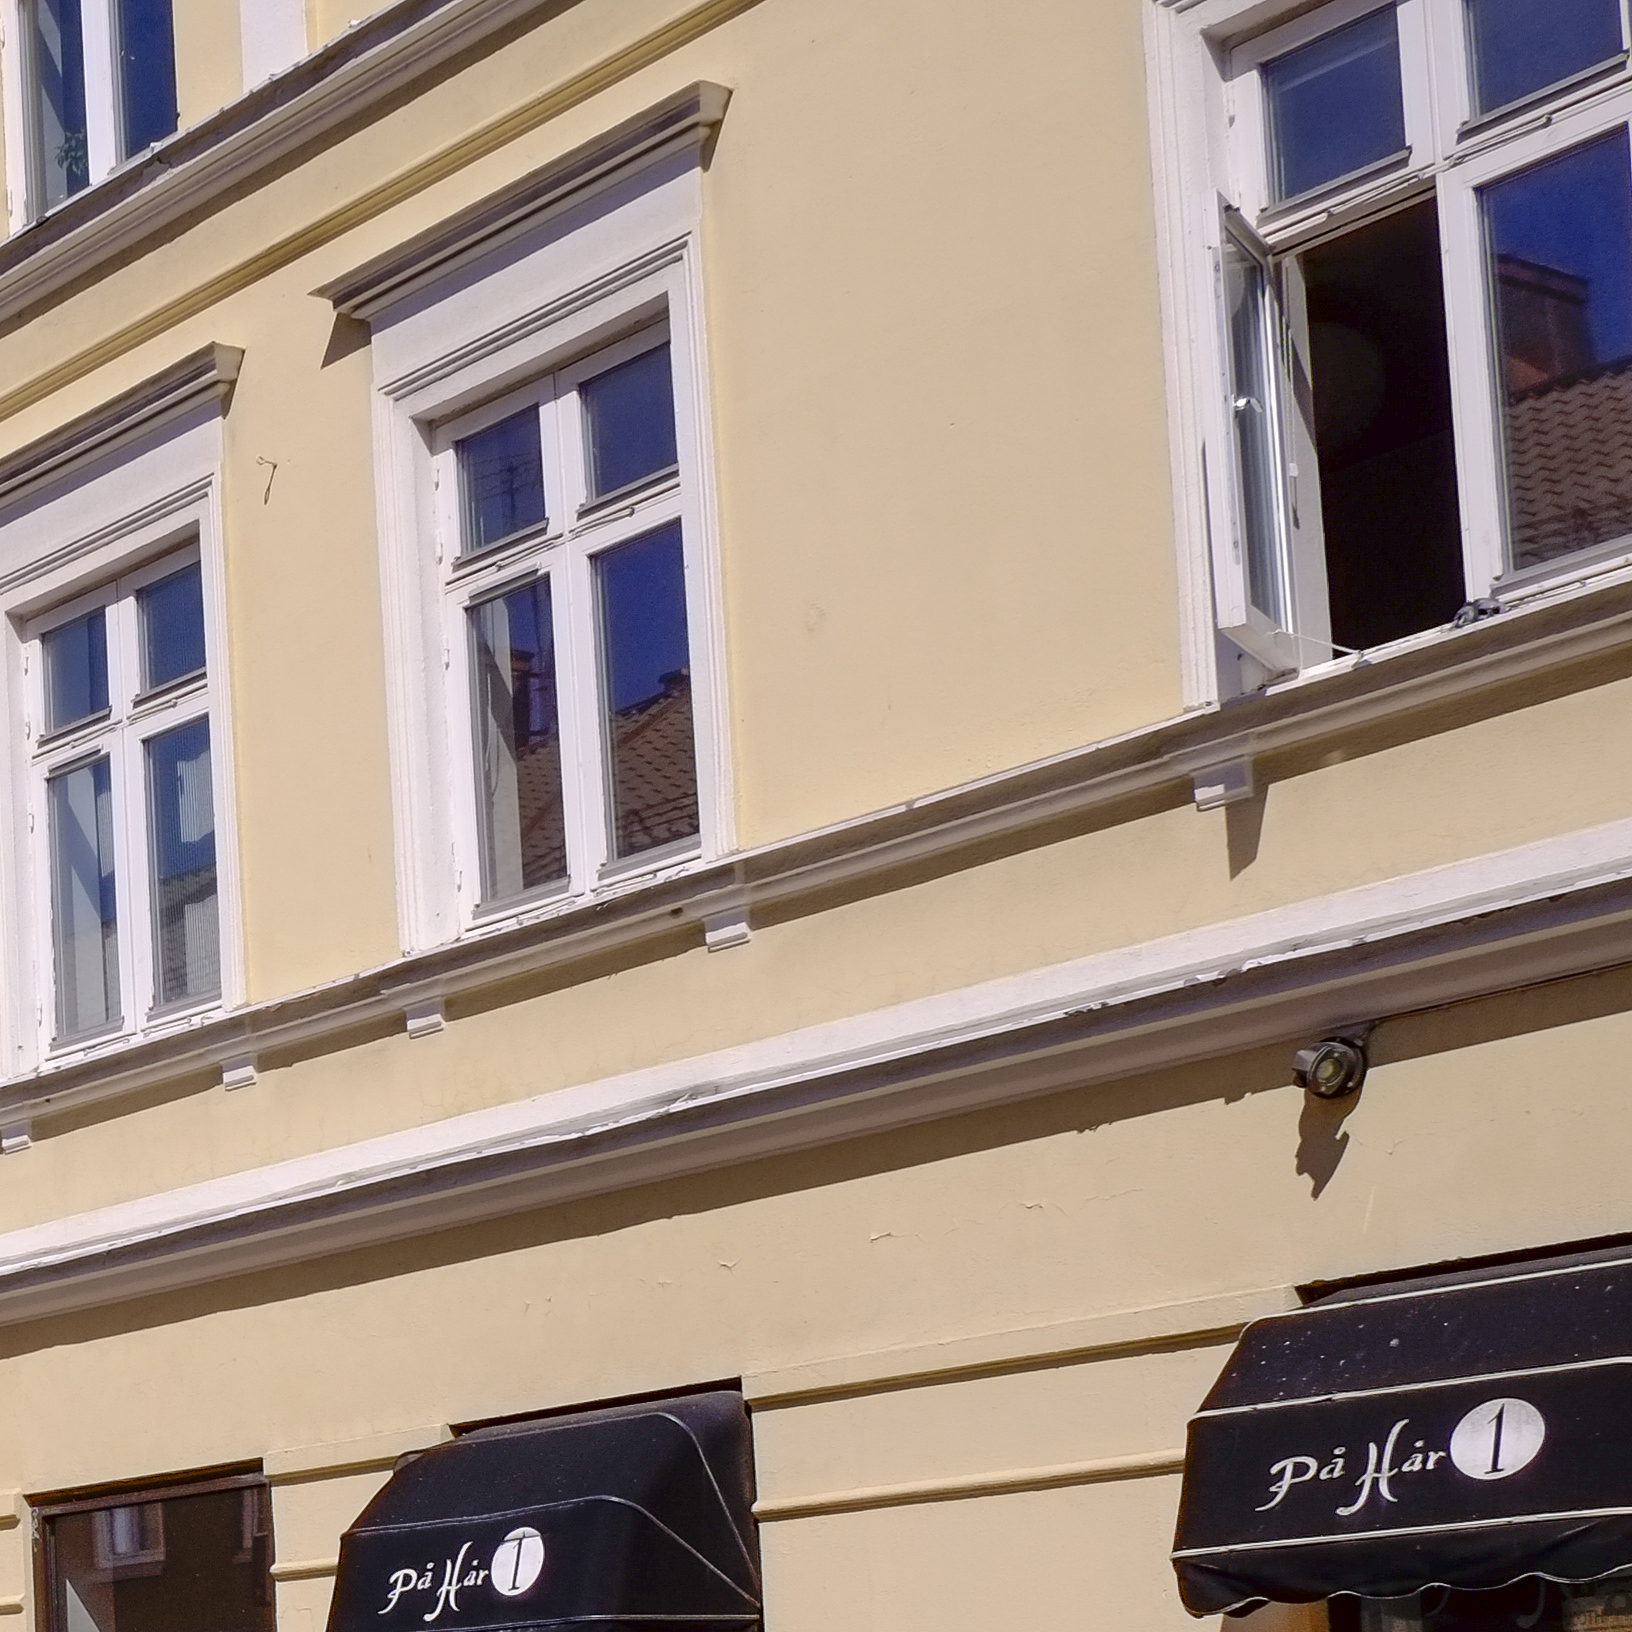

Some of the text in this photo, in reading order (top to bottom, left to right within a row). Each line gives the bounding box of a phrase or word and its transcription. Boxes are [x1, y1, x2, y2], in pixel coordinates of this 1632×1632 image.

[1254, 1402, 1506, 1517] På Hår 1
[377, 1562, 435, 1615] På
[422, 1541, 489, 1622] Hår
